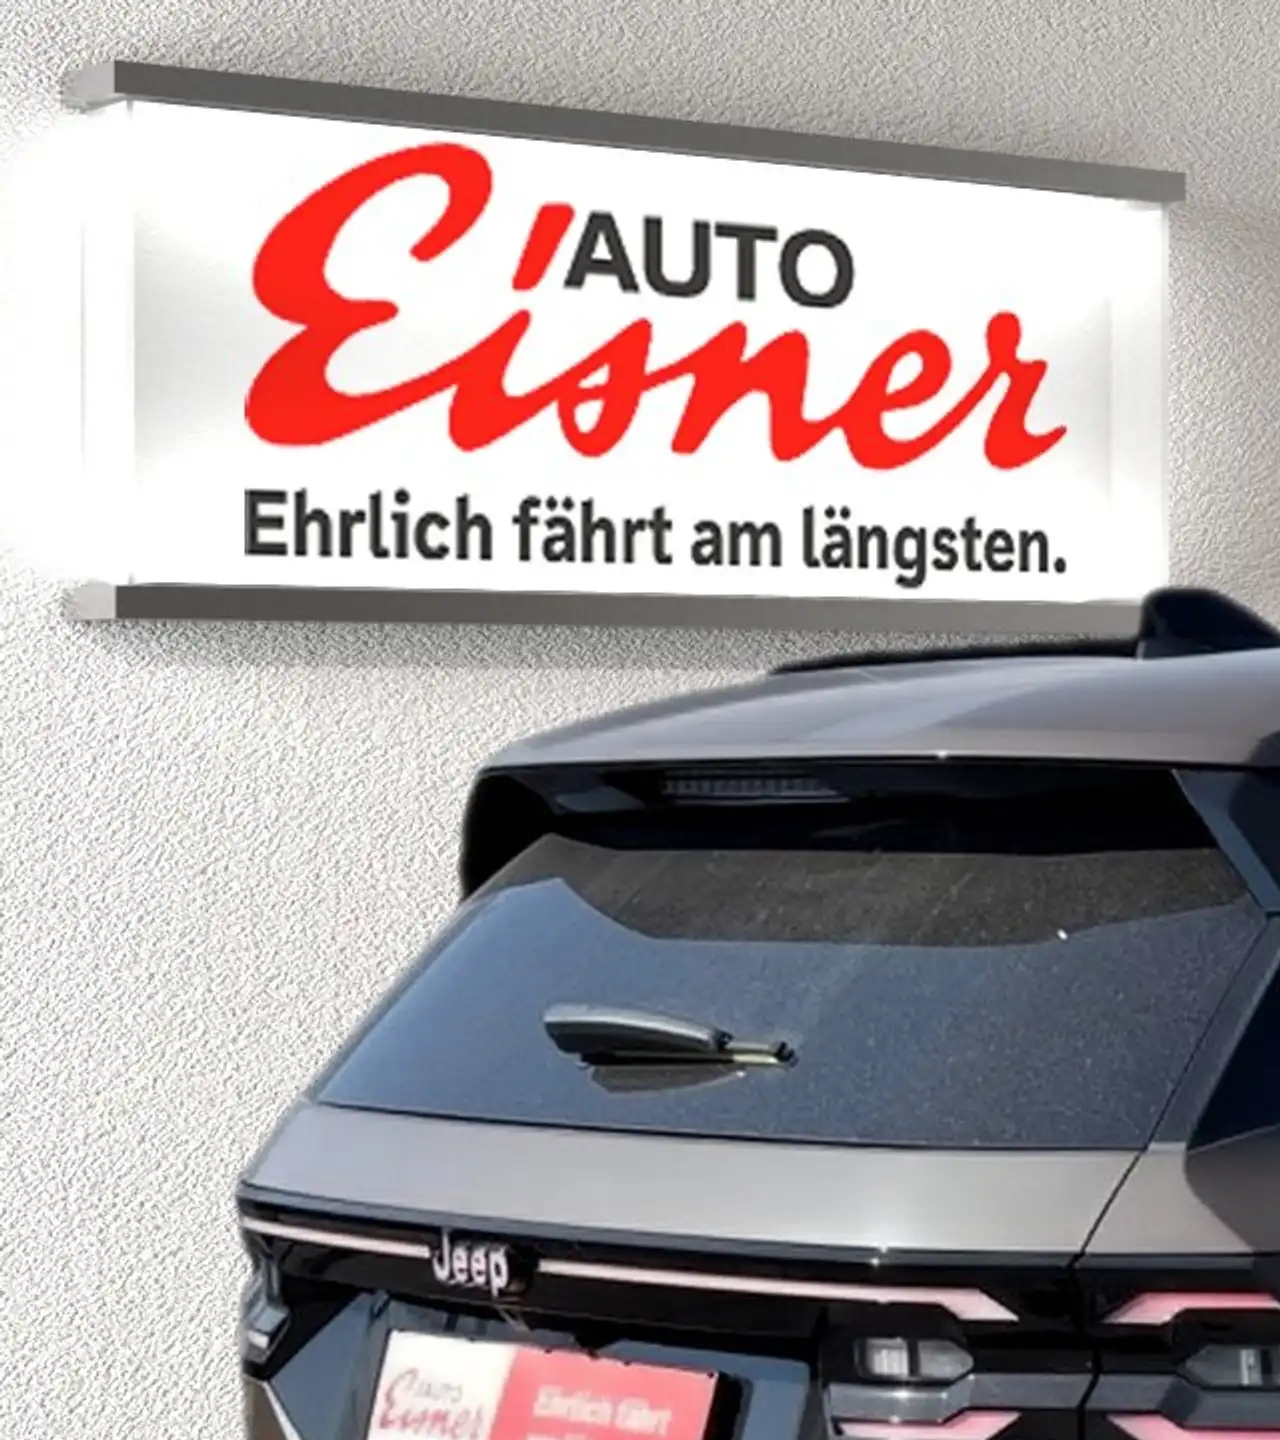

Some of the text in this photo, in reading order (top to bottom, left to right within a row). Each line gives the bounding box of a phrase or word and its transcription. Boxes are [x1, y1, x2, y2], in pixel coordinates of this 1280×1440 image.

[245, 144, 1065, 469] Eisner
[565, 213, 853, 307] AUTO
[245, 490, 1065, 587] Ehrlich fährt am längsten.
[431, 1230, 509, 1300] Jeep
